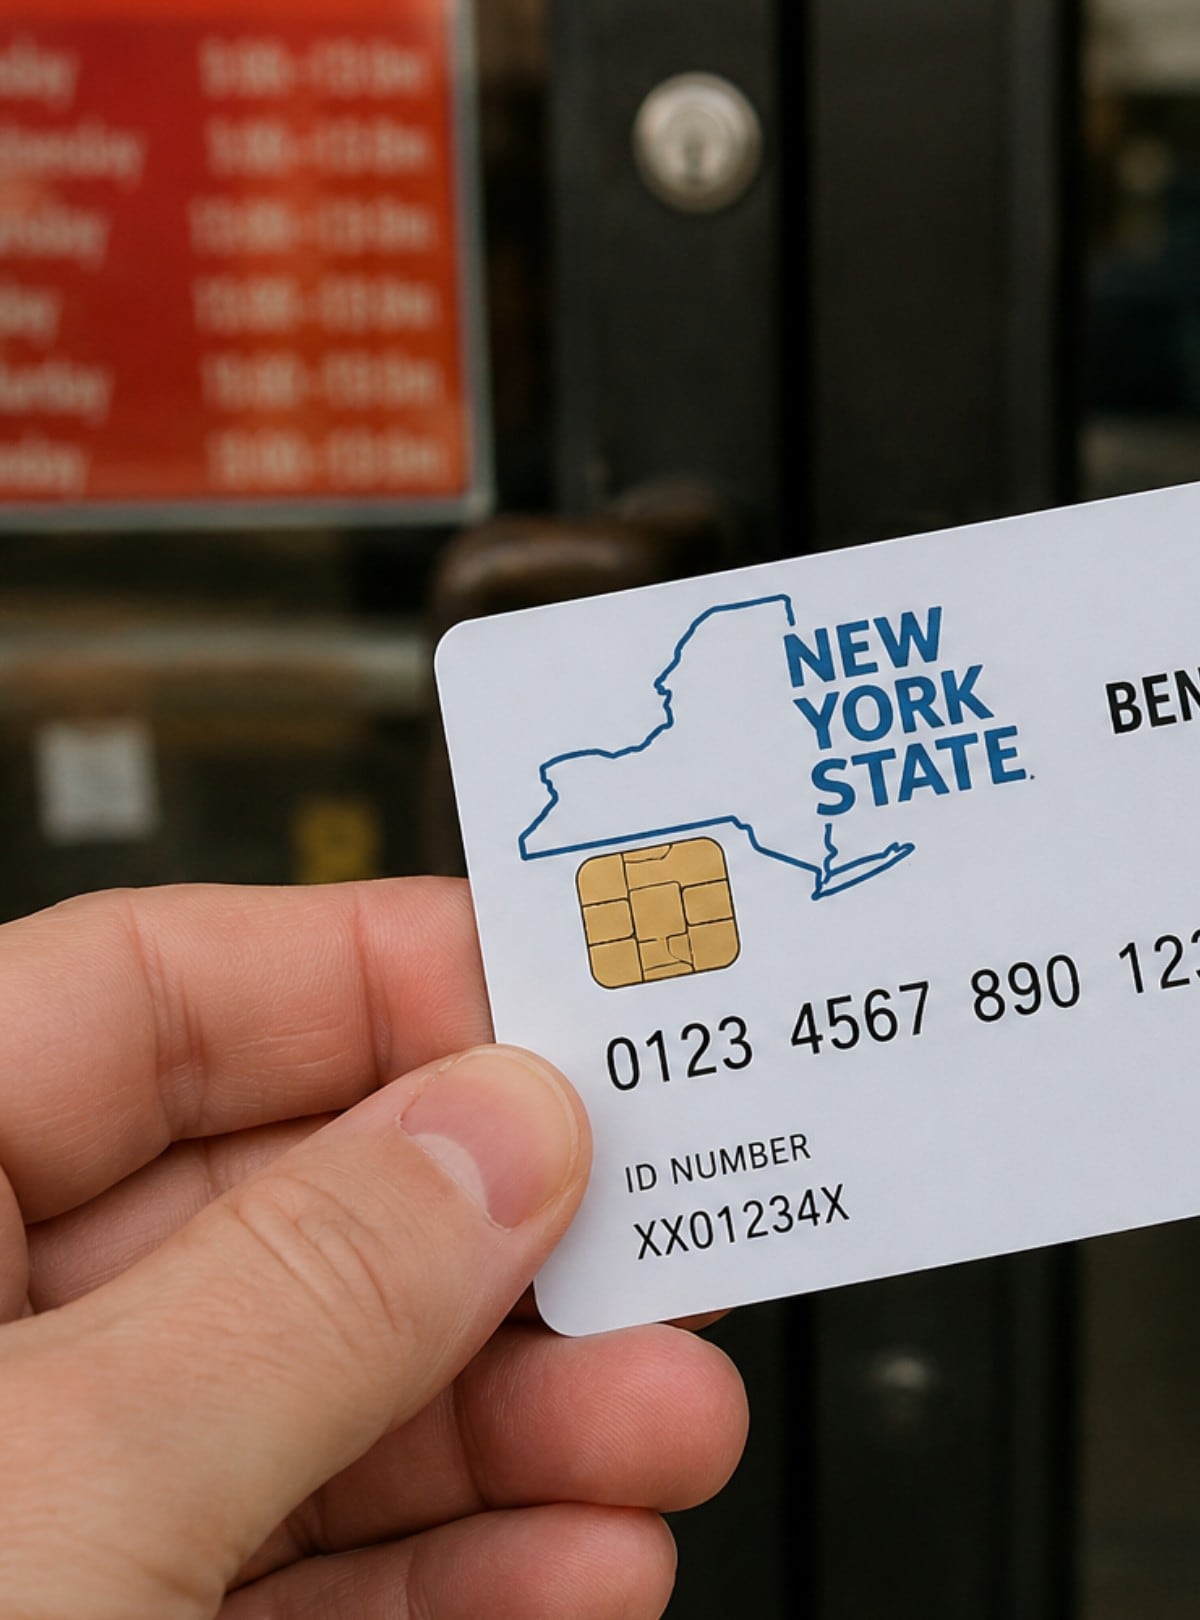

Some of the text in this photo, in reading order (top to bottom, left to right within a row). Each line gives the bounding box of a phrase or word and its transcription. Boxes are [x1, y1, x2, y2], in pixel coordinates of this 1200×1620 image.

[783, 606, 942, 688] NEW
[793, 664, 995, 750] YORK
[606, 1015, 753, 1092] 0123
[790, 981, 930, 1055] 4567
[970, 954, 1081, 1023] 890
[624, 1133, 811, 1194] ID NUMBER
[632, 1183, 850, 1261] XX01234X
